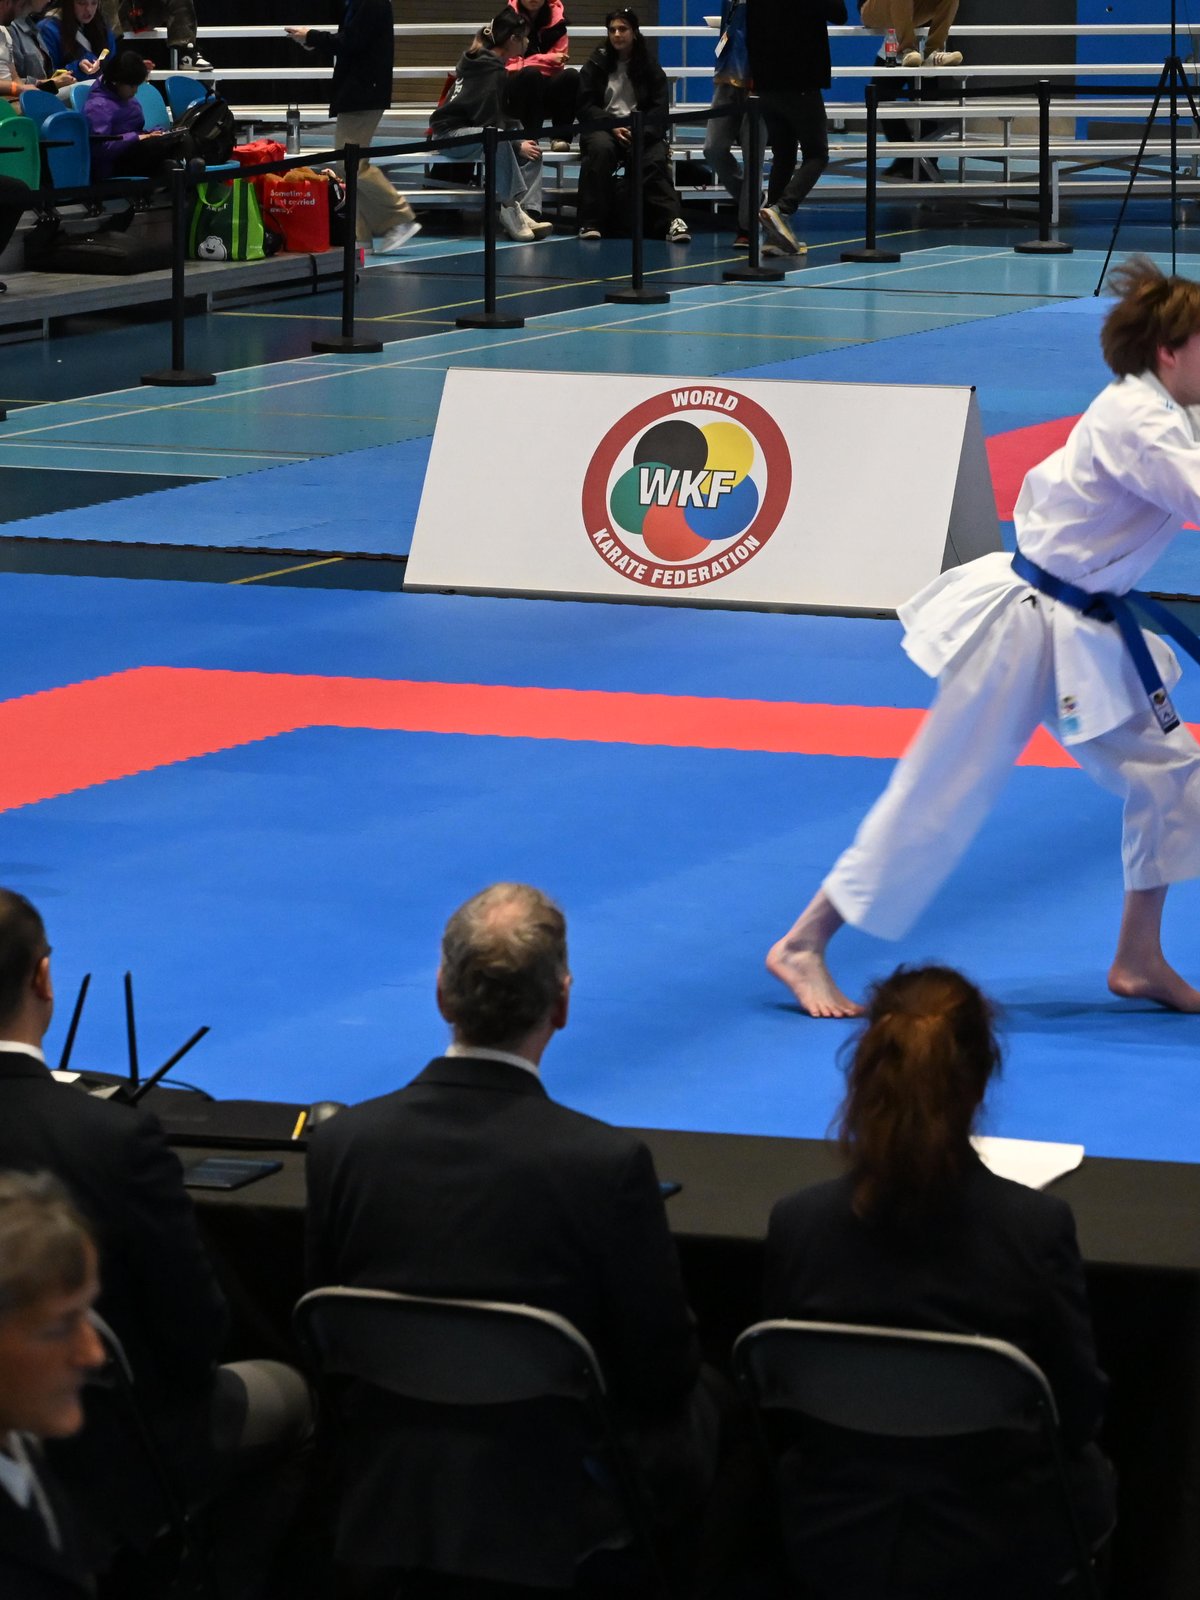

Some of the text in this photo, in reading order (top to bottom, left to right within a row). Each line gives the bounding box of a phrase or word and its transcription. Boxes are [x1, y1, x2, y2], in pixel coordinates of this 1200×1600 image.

[270, 189, 311, 198] Sometims
[671, 390, 739, 411] WORLD
[639, 467, 736, 509] WKF
[592, 528, 761, 586] KARATE FEDERATION
